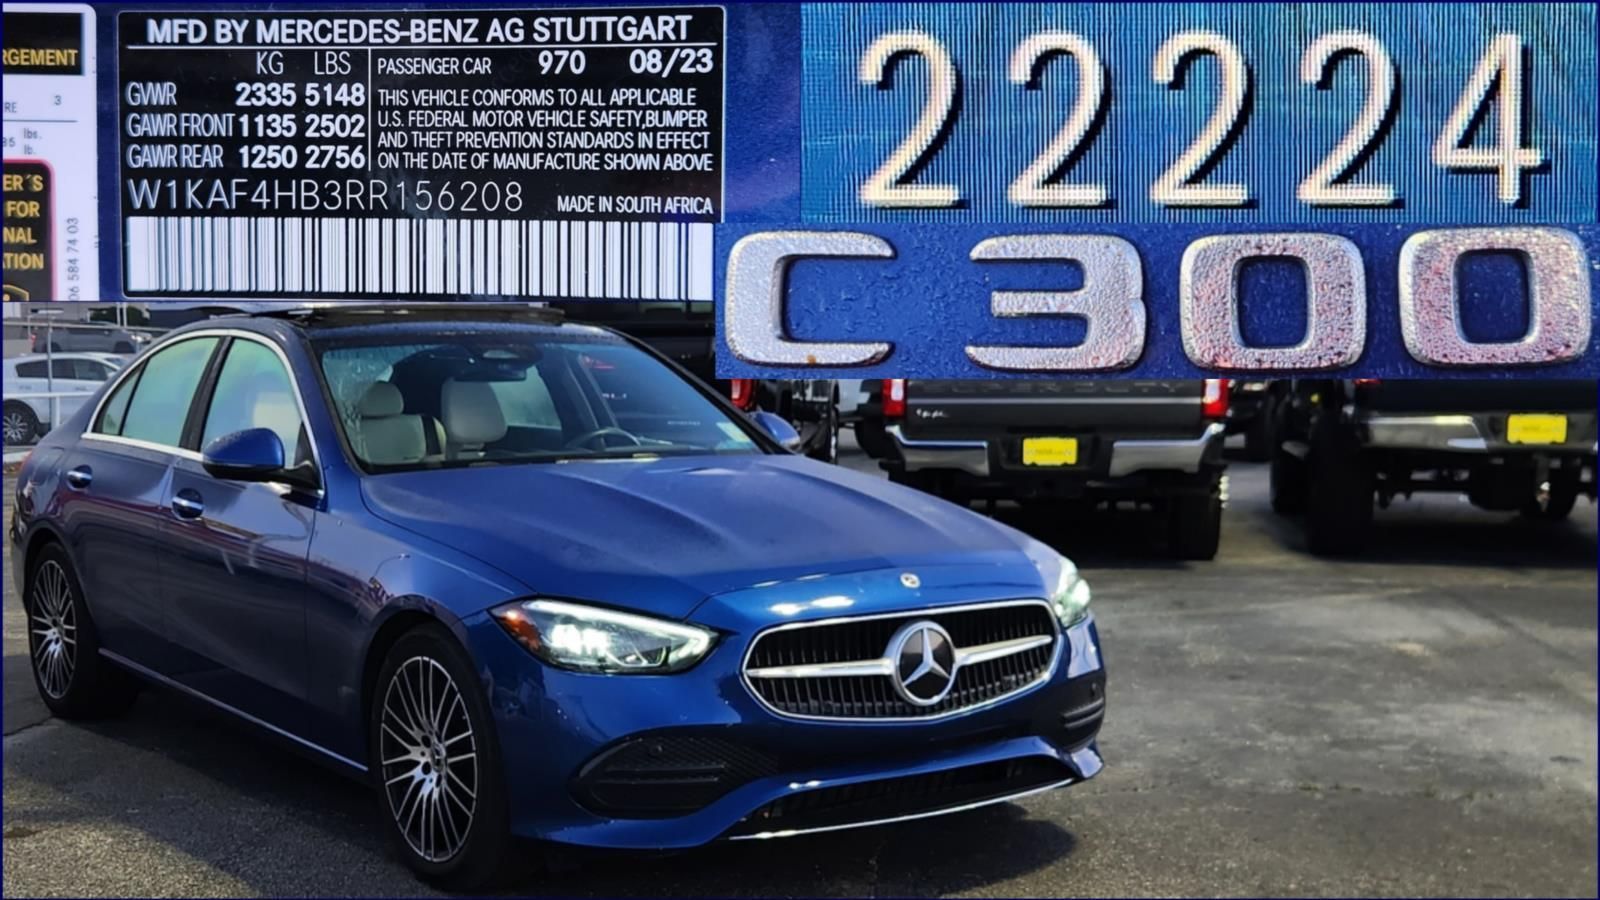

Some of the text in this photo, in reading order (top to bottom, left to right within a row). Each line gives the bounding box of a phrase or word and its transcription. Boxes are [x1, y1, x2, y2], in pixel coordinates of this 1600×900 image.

[147, 15, 692, 44] MFD BY MERCEDES-BENZ AG STUTTGART
[256, 51, 351, 75] KG LBS
[378, 48, 713, 78] PASSENGER CAR 970 08/23
[54, 95, 62, 106] 3
[126, 82, 365, 106] GVWR 2335 5148
[378, 88, 697, 106] THIS VEHICLE CONFORMS TO ALL APPLICABLE
[126, 113, 366, 138] GAWR FRONT 1135 2502
[378, 111, 405, 127] U.S.
[409, 110, 468, 127] FEDERAL
[472, 110, 523, 127] MOTOR
[528, 110, 586, 127] VEHICLE
[858, 30, 1543, 207] 22224
[378, 131, 711, 148] AND THEFT PREVENTION STANDARDS IN EFFECT
[126, 145, 366, 169] GAWR REAR 1250 2756
[378, 153, 713, 171] ON THE DATE OF MANUFACTURE SHOWN ABOVE
[127, 179, 523, 211] W1KAF4HB3RR156208
[557, 195, 713, 214] MADE IN SOUTH AFRICA
[7, 201, 40, 217] FOR
[3, 227, 37, 244] NAL
[66, 217, 79, 234] 03
[3, 252, 44, 269] TION
[67, 258, 80, 281] 584
[726, 226, 1592, 369] C 300
